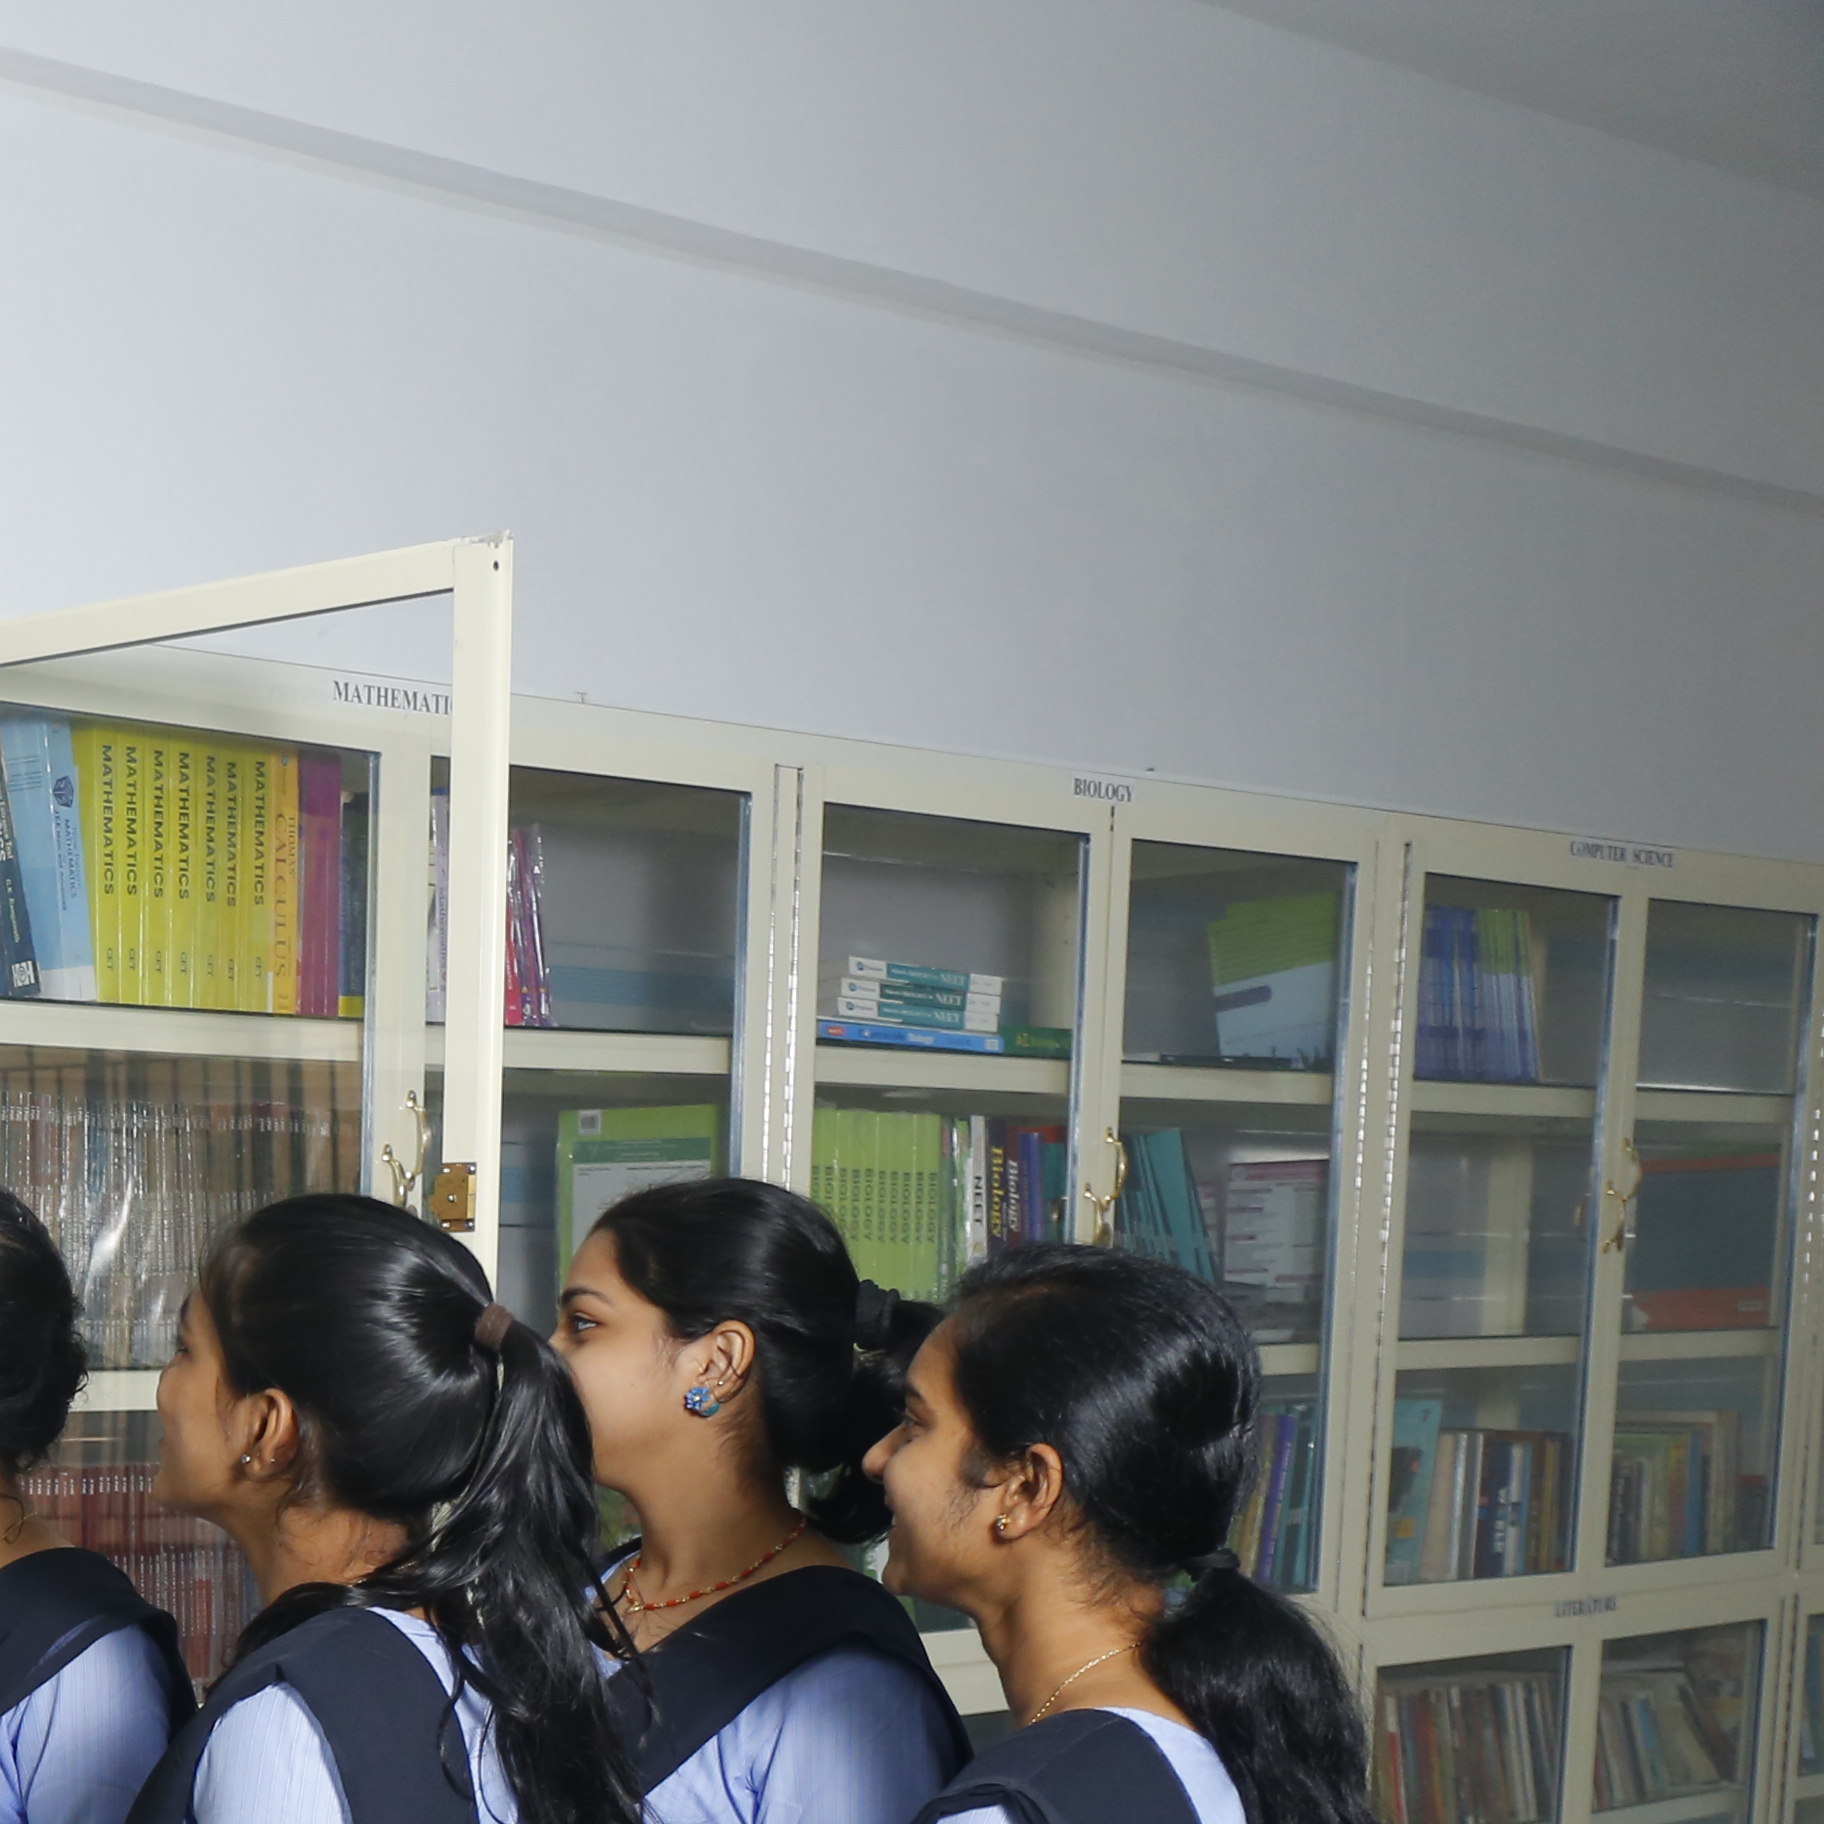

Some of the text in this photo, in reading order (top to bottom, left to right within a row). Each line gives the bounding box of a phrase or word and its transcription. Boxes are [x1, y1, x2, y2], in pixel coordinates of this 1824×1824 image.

[333, 680, 452, 715] MATHEMATI
[101, 744, 115, 896] MATHEMATICS
[126, 746, 138, 896] MATHEMATICS
[1075, 778, 1132, 802] BIOLOGY
